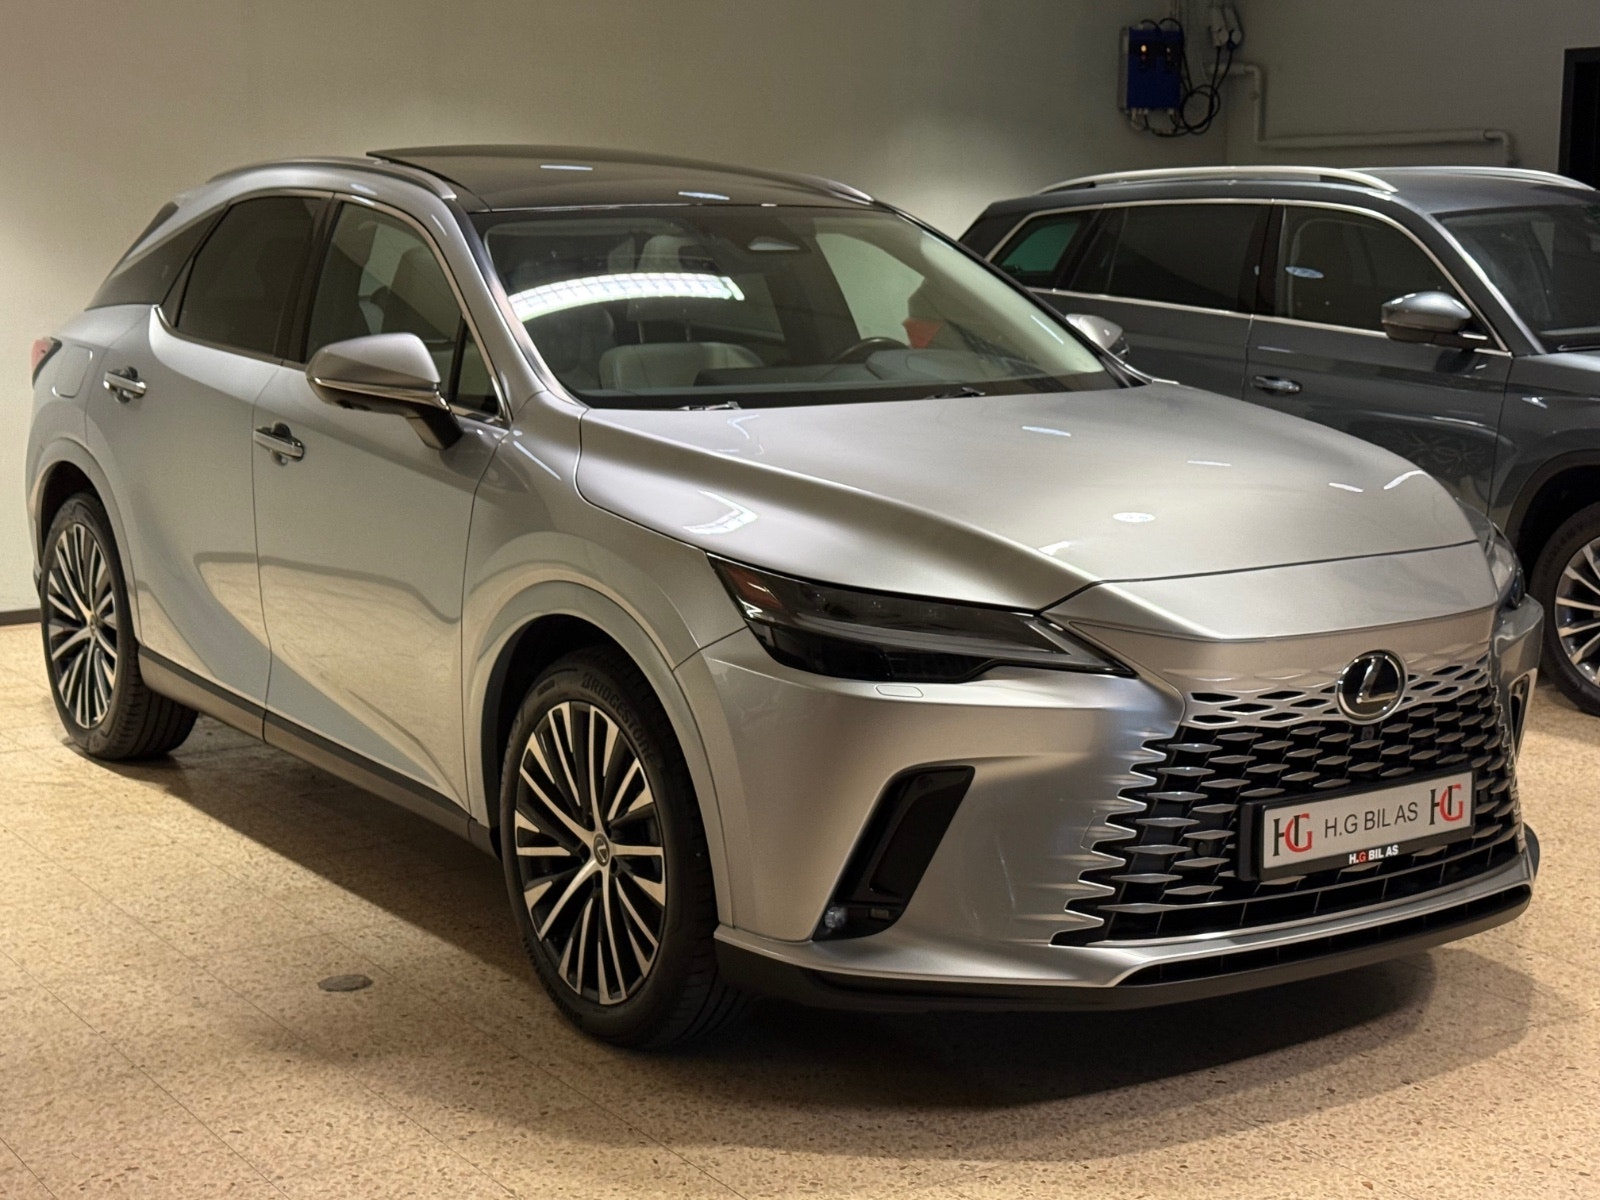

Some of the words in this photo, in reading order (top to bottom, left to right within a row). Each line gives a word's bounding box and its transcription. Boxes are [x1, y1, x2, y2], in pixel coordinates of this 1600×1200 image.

[1324, 814, 1358, 839] H.G
[1349, 851, 1367, 865] H.G
[1368, 847, 1384, 861] BIL
[1385, 844, 1399, 857] AS
